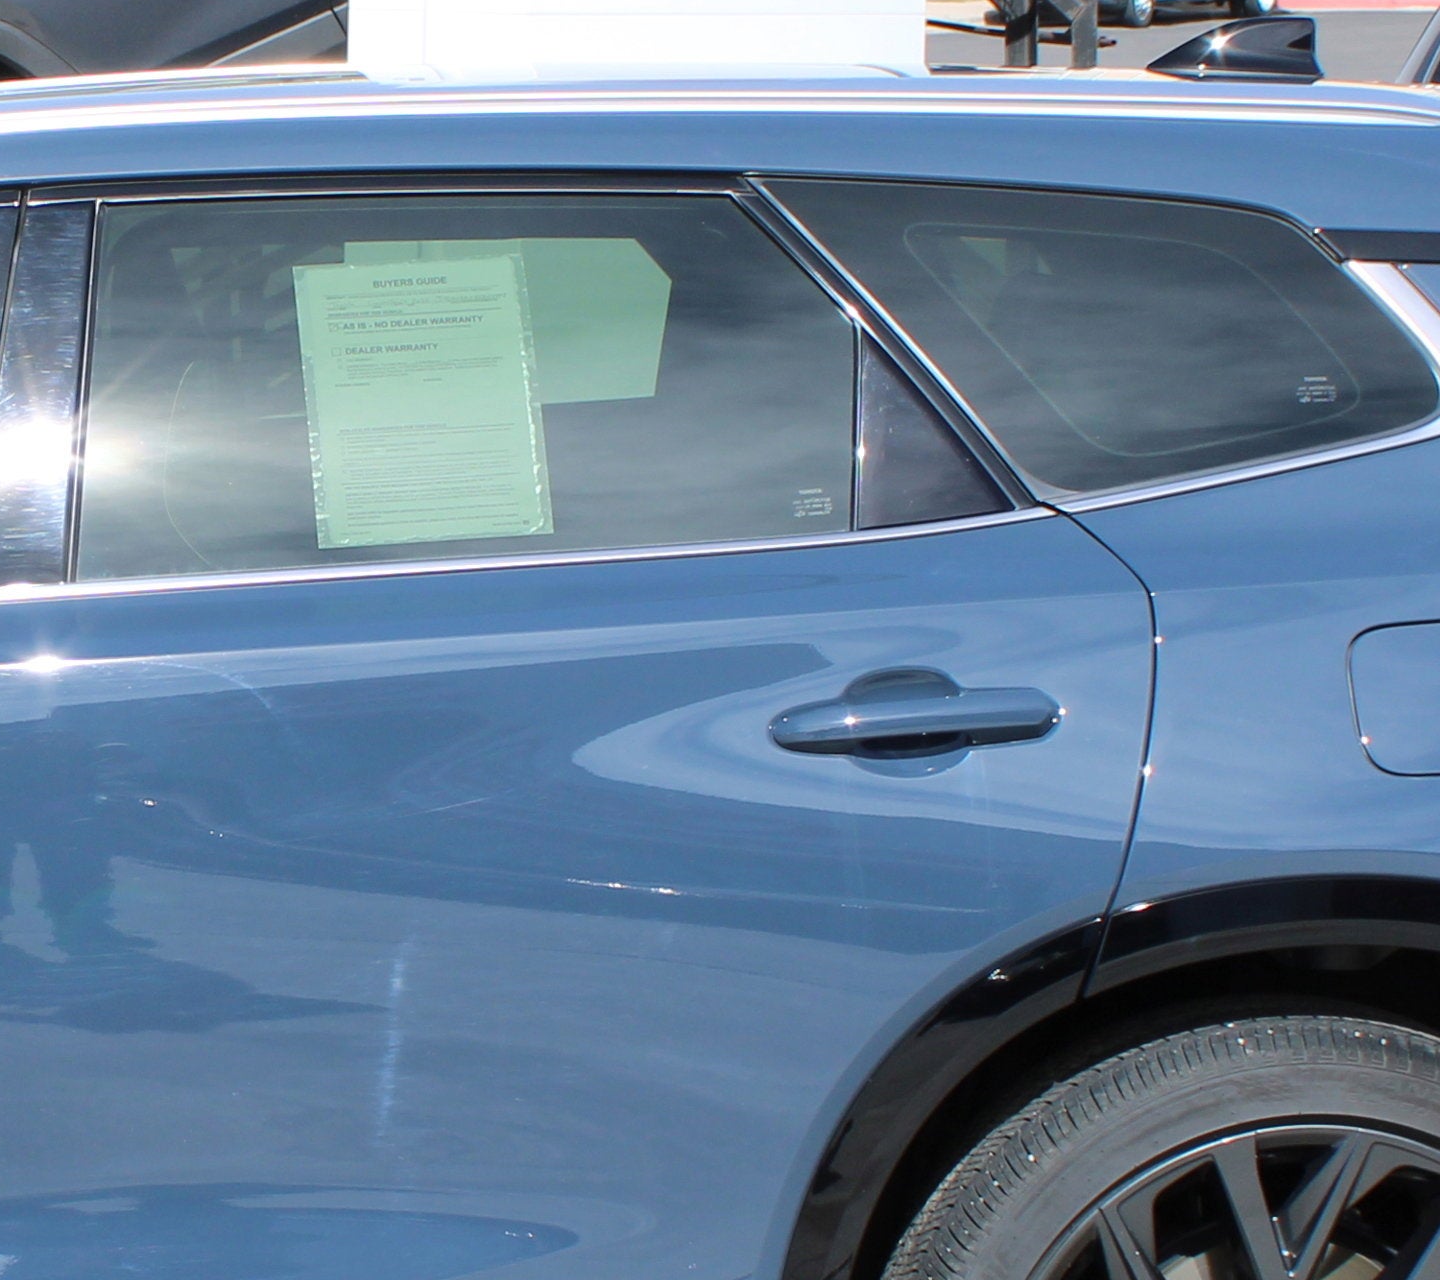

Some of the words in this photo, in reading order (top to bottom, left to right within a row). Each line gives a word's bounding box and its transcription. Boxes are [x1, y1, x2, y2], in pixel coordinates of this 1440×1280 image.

[372, 278, 414, 289] BUYERS
[416, 276, 448, 286] GUIDE
[343, 323, 355, 331] AS
[357, 322, 367, 330] IS
[374, 321, 389, 329] NO
[390, 319, 428, 328] DEALER
[429, 315, 484, 326] WARRANTY
[345, 345, 384, 356] DEALER
[384, 342, 439, 353] WARRANTY
